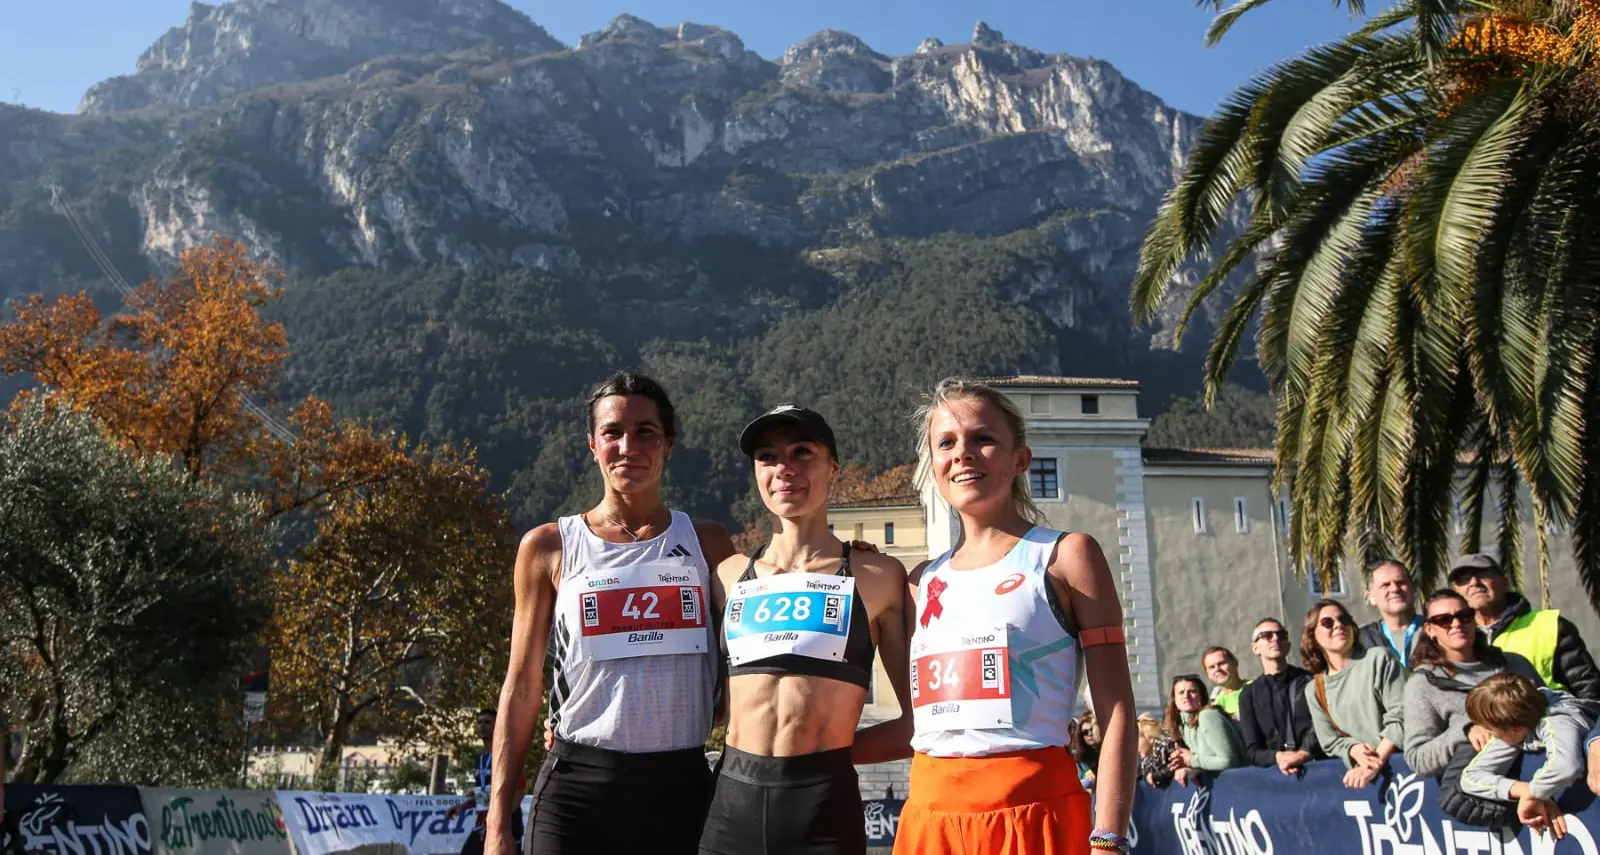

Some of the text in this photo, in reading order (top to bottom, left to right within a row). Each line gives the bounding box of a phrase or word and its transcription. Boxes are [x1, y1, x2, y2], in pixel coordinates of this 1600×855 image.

[658, 574, 690, 582] TRENTINO
[806, 580, 841, 591] TRENTINO
[621, 592, 660, 620] 42
[754, 596, 812, 624] 628
[628, 631, 664, 643] Barilla
[763, 631, 800, 643] Barilla
[929, 658, 960, 691] 34
[931, 703, 960, 716] Barilla
[294, 797, 378, 841] Dryarn
[385, 798, 473, 846] Dryar
